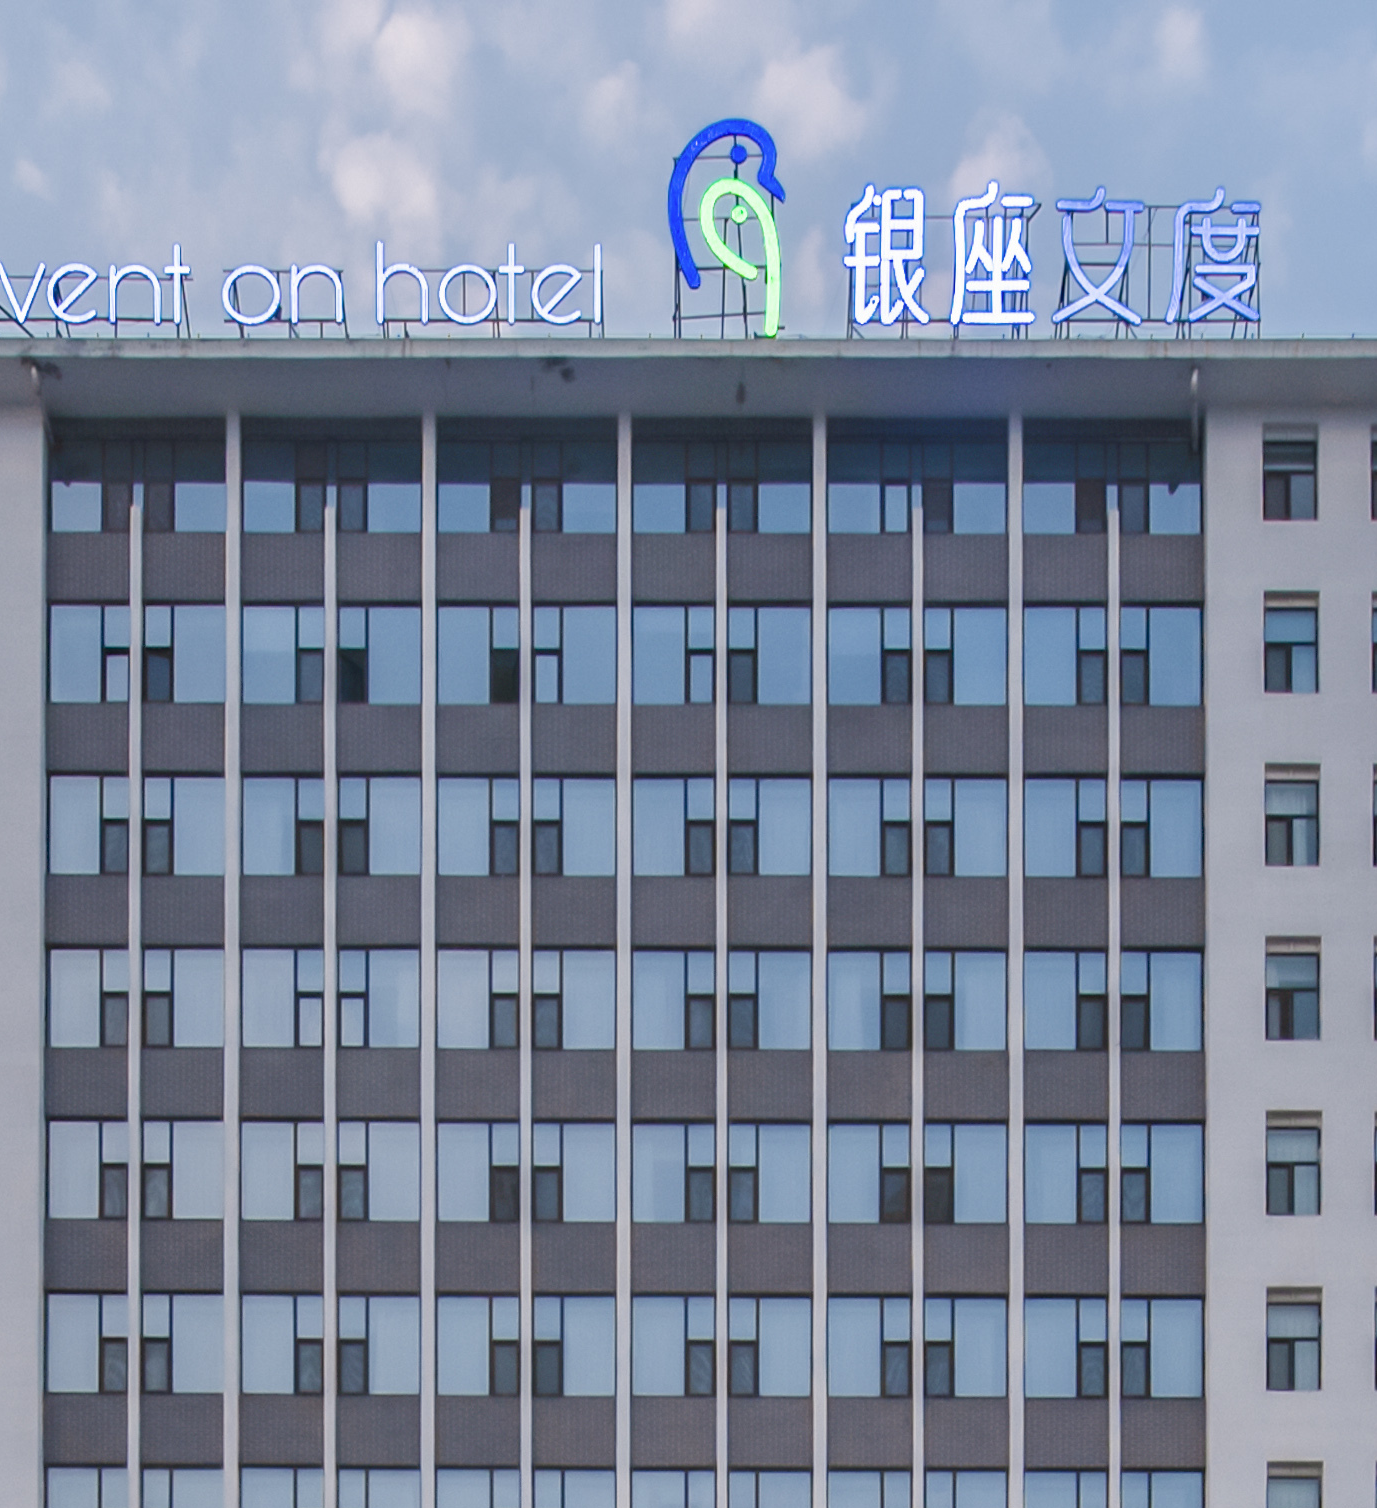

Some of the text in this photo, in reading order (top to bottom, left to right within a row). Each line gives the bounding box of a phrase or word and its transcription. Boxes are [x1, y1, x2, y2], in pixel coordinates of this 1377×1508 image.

[220, 263, 345, 325] on
[375, 240, 603, 325] hotel
[842, 181, 1263, 326] 银座文度
